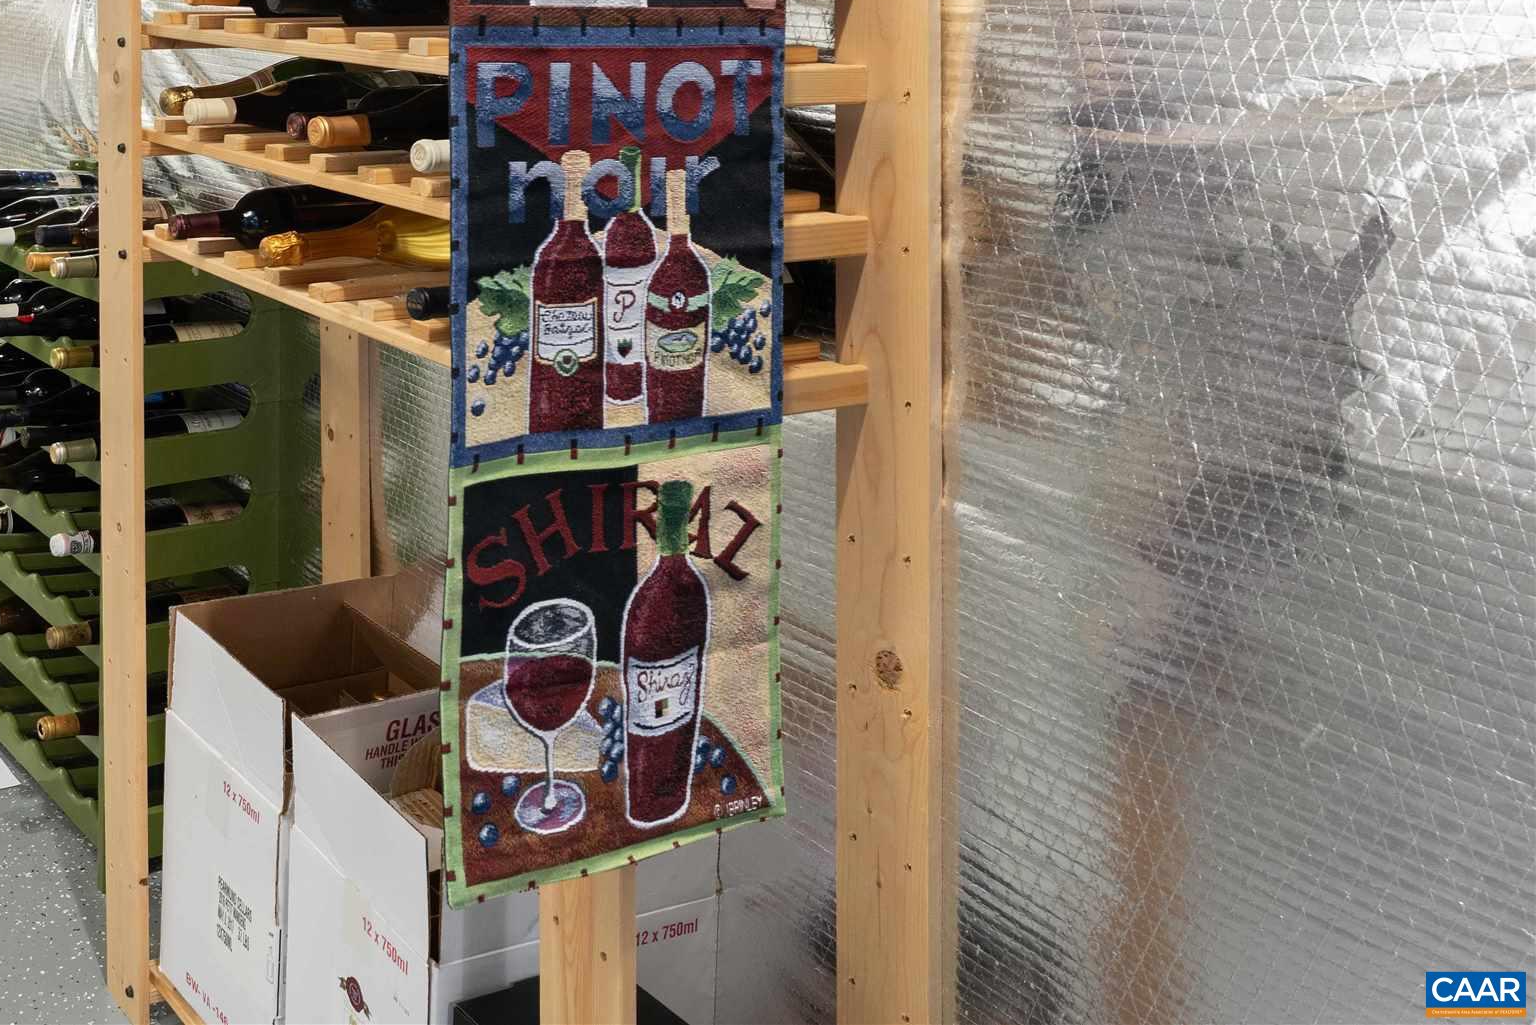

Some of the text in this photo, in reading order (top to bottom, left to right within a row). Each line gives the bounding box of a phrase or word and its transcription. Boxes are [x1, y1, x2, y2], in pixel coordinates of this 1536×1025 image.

[475, 59, 763, 149] PINOT
[508, 154, 721, 224] noir
[613, 290, 636, 323] P
[467, 480, 762, 609] SHIRAZ
[637, 663, 695, 706] Shiraz
[365, 738, 409, 761] HANDLE
[223, 780, 232, 797] 12
[238, 794, 260, 825] 750ml
[362, 916, 373, 937] 12
[381, 935, 409, 976] 750ml
[636, 918, 699, 947] 12 x 750ml
